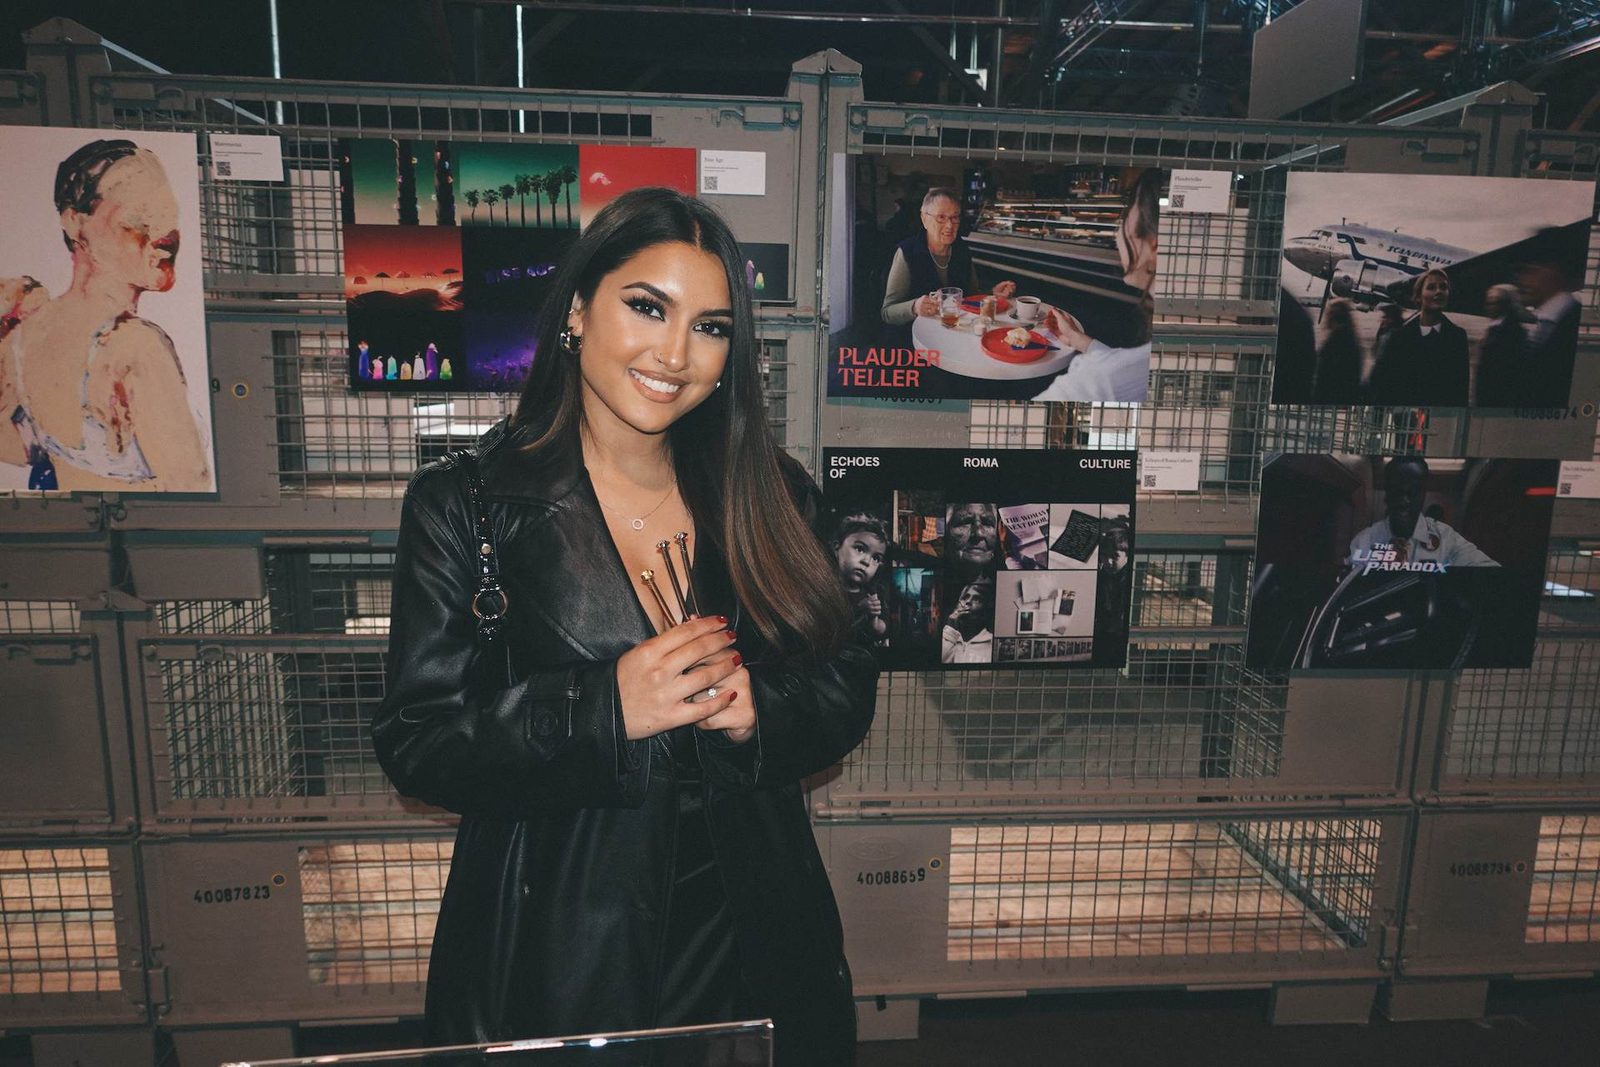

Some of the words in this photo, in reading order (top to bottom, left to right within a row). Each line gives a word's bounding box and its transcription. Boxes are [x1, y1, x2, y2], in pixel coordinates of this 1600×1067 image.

[839, 347, 943, 368] PLAUDER
[838, 368, 920, 388] TELLER
[831, 456, 880, 467] ECHOES
[963, 458, 999, 468] ROMA
[1079, 459, 1132, 469] CULTURE
[830, 468, 847, 479] OF
[1005, 516, 1020, 524] THE
[1020, 510, 1047, 522] WOMAN
[1008, 521, 1027, 531] NEXT
[1027, 516, 1047, 528] DOOR
[1352, 549, 1397, 561] USB
[1362, 561, 1451, 576] PARADOX
[857, 867, 926, 885] 40088659
[193, 885, 270, 903] 40087823
